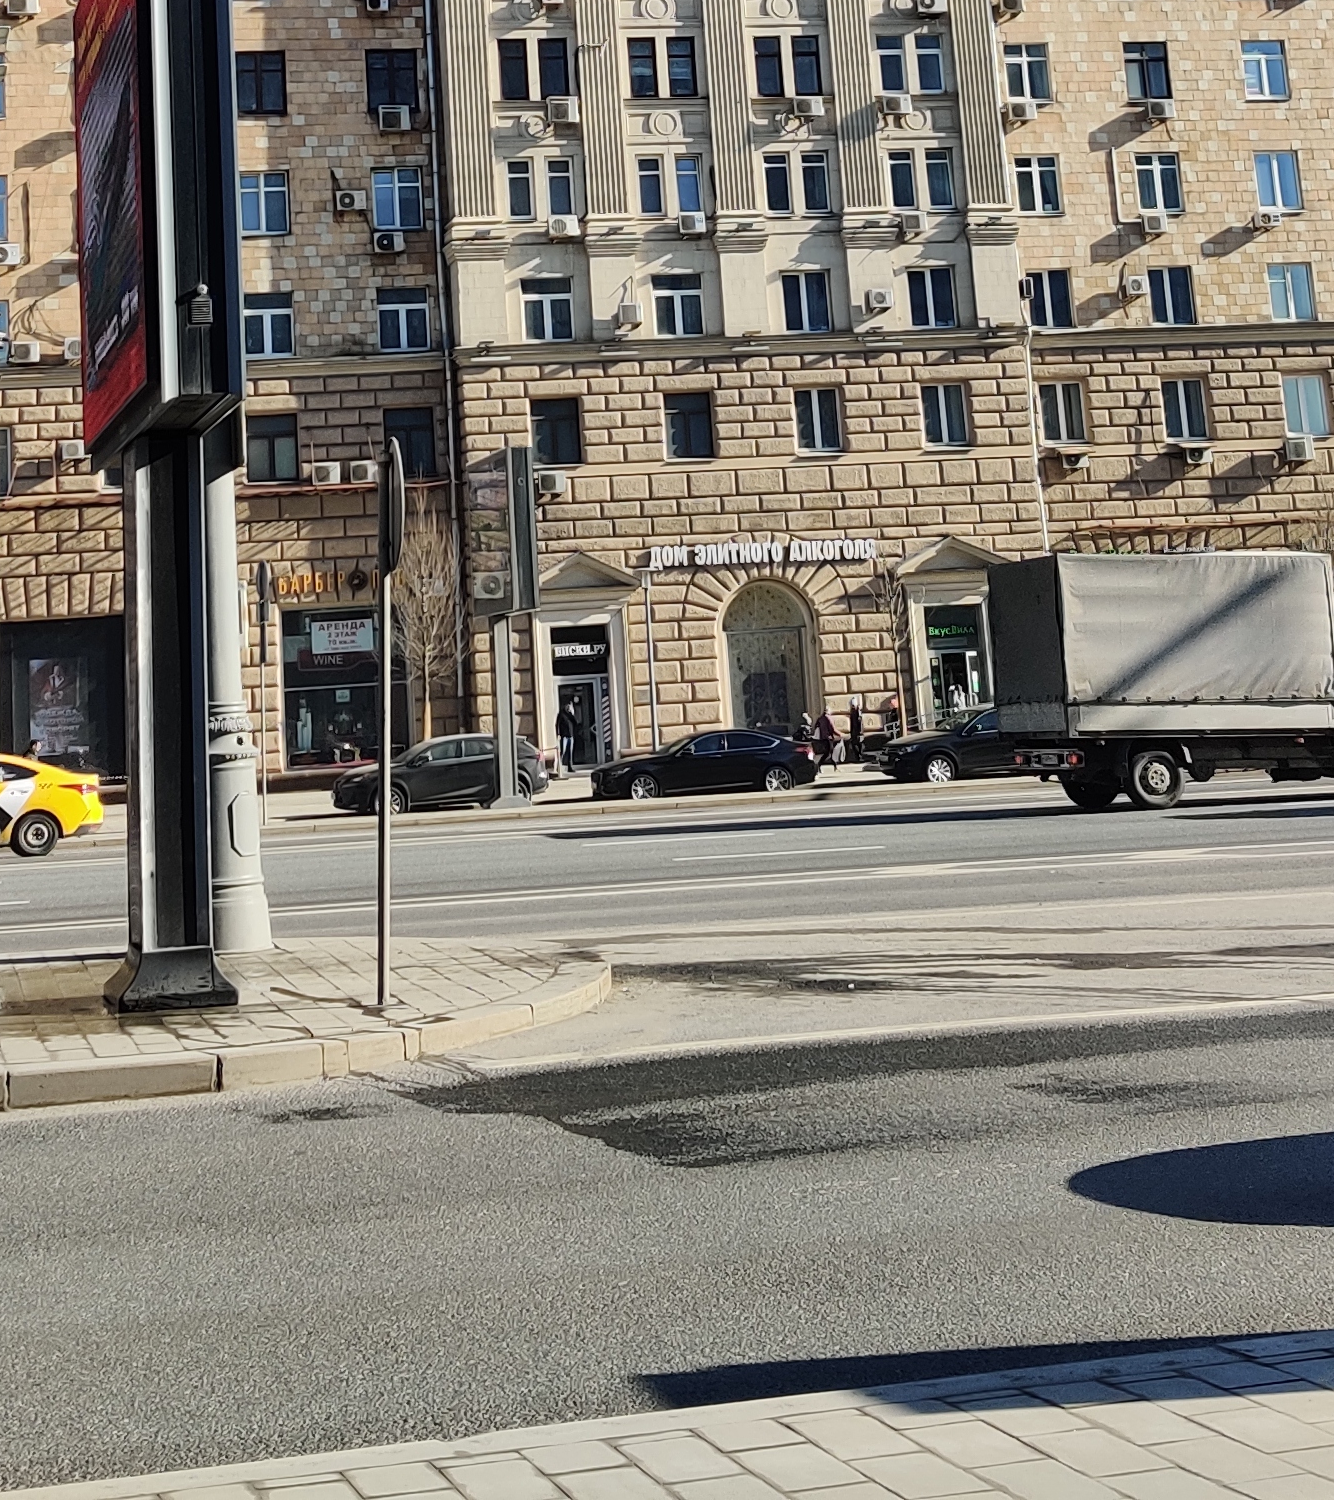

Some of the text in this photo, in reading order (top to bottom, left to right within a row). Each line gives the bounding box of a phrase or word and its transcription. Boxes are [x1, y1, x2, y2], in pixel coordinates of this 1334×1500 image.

[649, 538, 876, 570] ДОМ ЭЛИТНОГО АЛКОГОЛЯ
[278, 570, 346, 594] БАРБЕР
[318, 621, 366, 632] АРЕНДА
[312, 654, 344, 666] WINE
